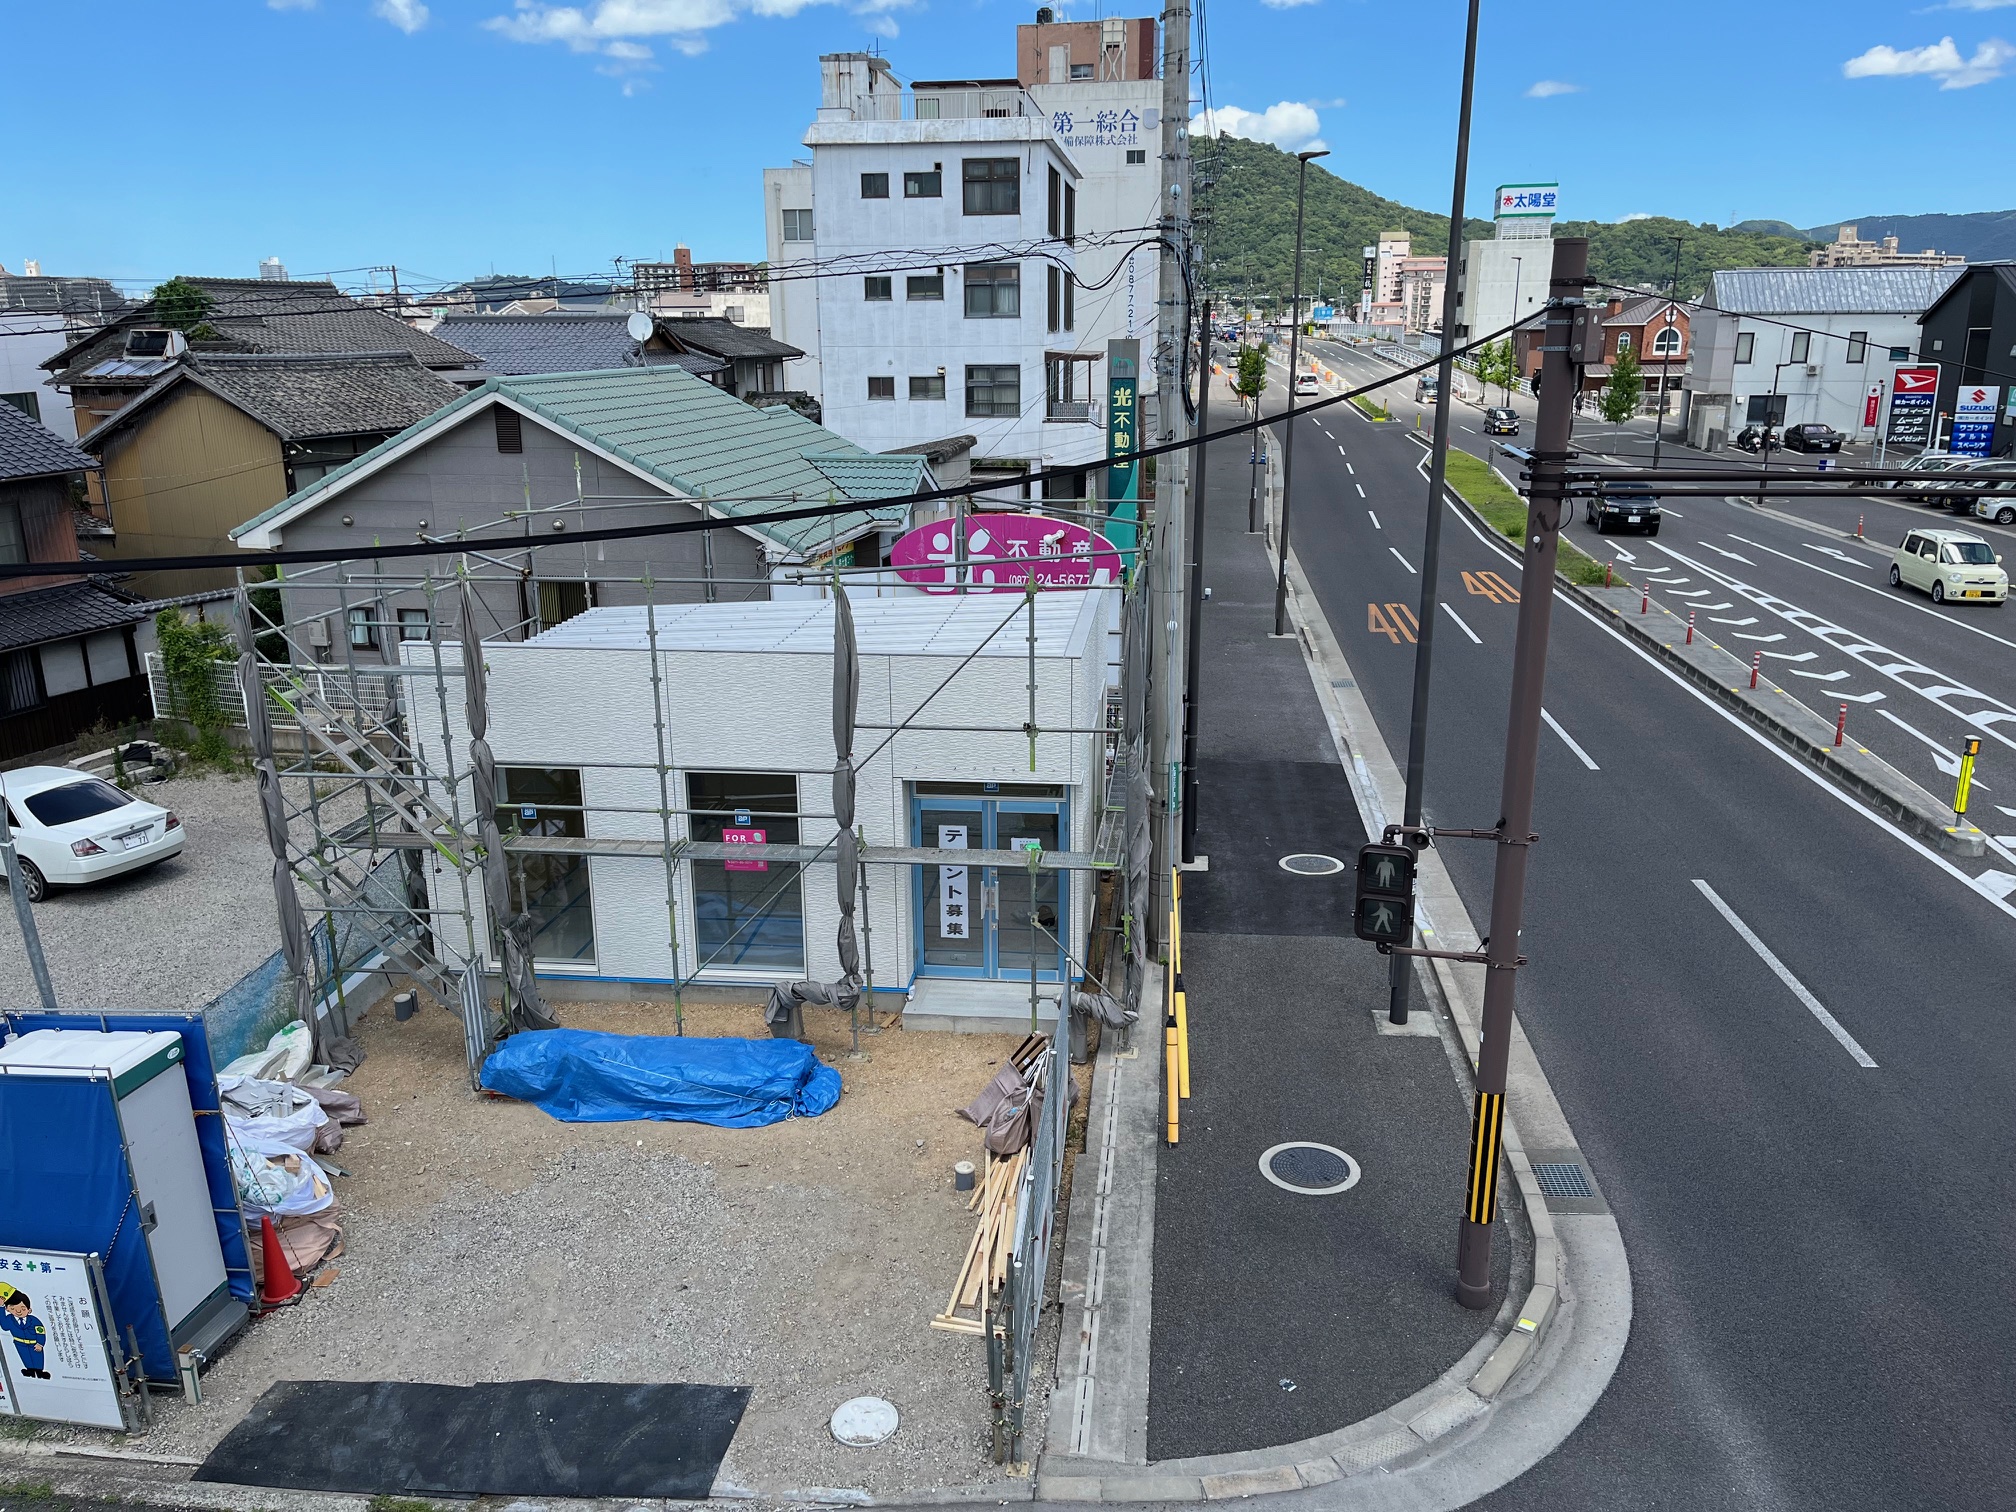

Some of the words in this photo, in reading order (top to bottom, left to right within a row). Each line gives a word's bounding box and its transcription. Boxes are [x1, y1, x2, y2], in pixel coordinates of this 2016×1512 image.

[1053, 109, 1139, 134] 第一綜合
[1061, 134, 1138, 147] 備保障株式会社
[1514, 192, 1556, 208] 太陽堂
[1461, 572, 1520, 603] 40
[1368, 603, 1419, 644] 40
[945, 829, 963, 936] テント募集
[0, 1259, 23, 1271] 安全
[40, 1261, 66, 1274] 第一
[79, 1297, 93, 1331] お願い
